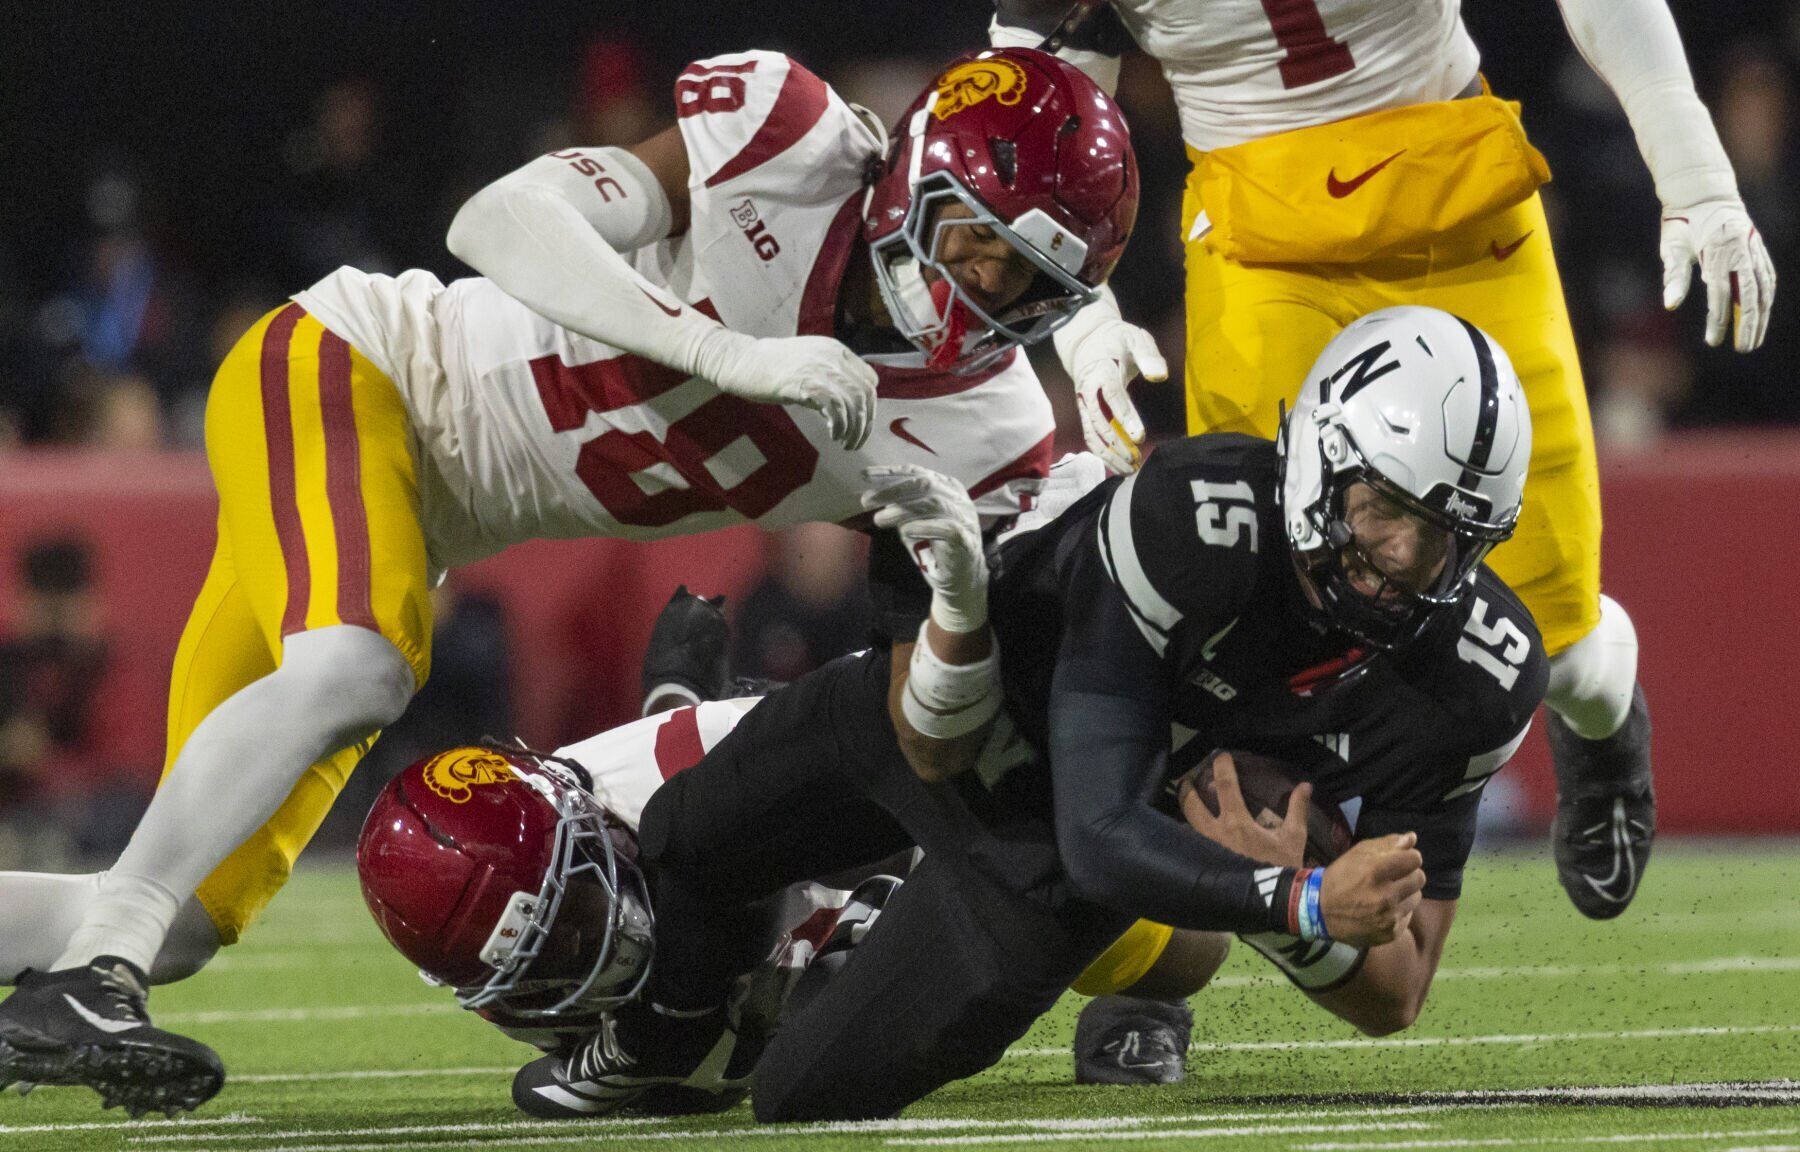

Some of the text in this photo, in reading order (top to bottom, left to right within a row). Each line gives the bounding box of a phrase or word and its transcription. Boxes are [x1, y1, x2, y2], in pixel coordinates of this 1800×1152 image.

[549, 152, 628, 203] USC
[1331, 340, 1401, 404] N
[1190, 479, 1259, 554] 15
[1456, 597, 1531, 692] 15
